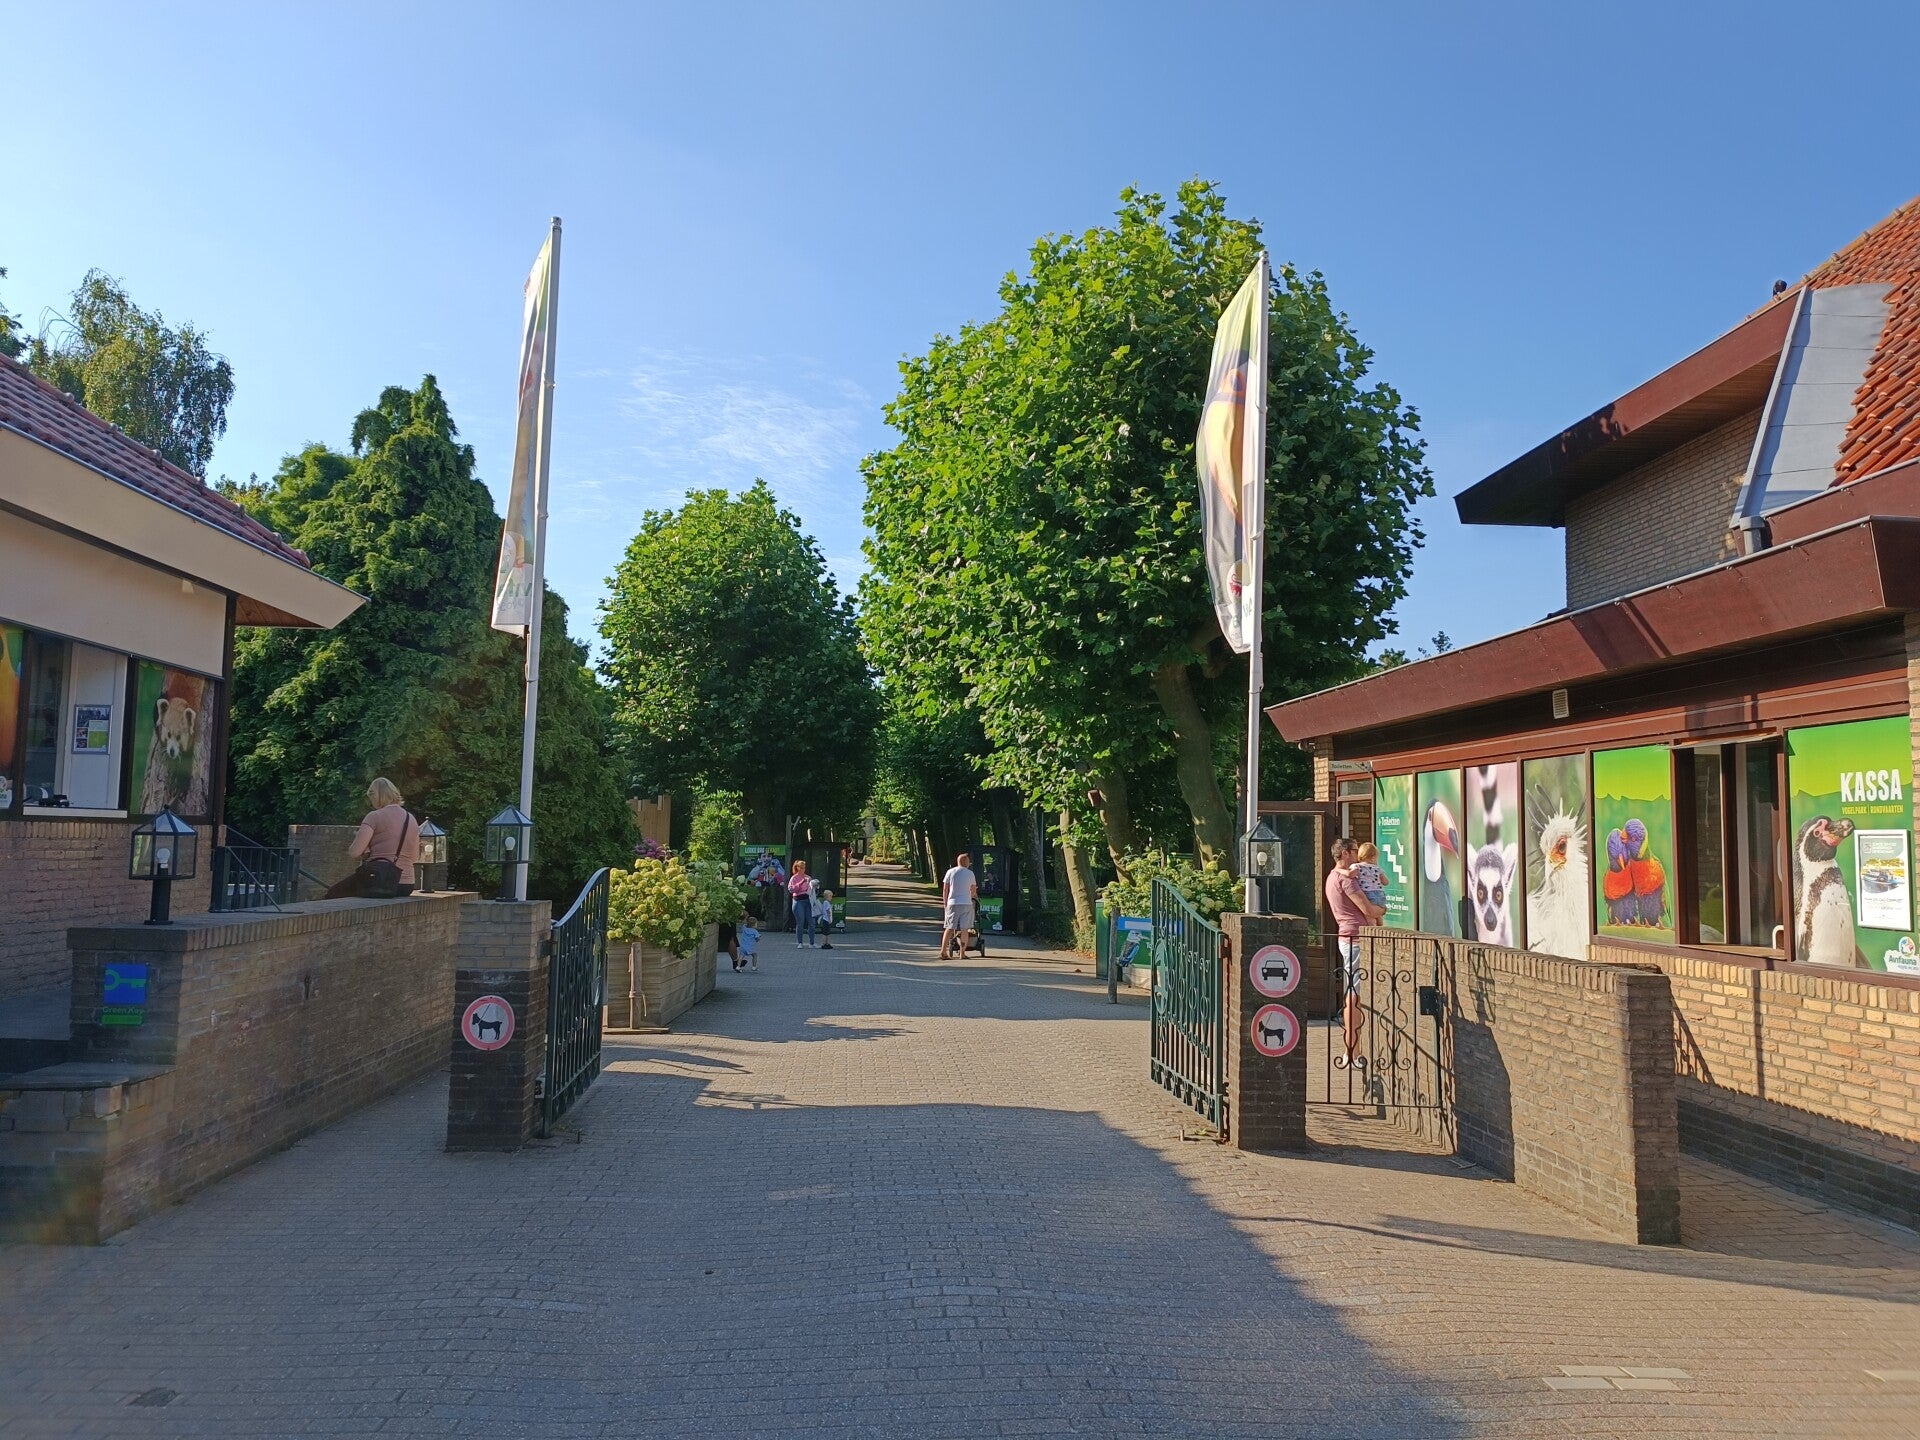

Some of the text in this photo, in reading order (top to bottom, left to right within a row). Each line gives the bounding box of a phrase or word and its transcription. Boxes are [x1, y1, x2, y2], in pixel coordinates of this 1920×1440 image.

[1840, 769, 1903, 803] KASSA
[1841, 804, 1904, 815] VOGELPARK RONDVAARTEN
[102, 1006, 127, 1014] Green
